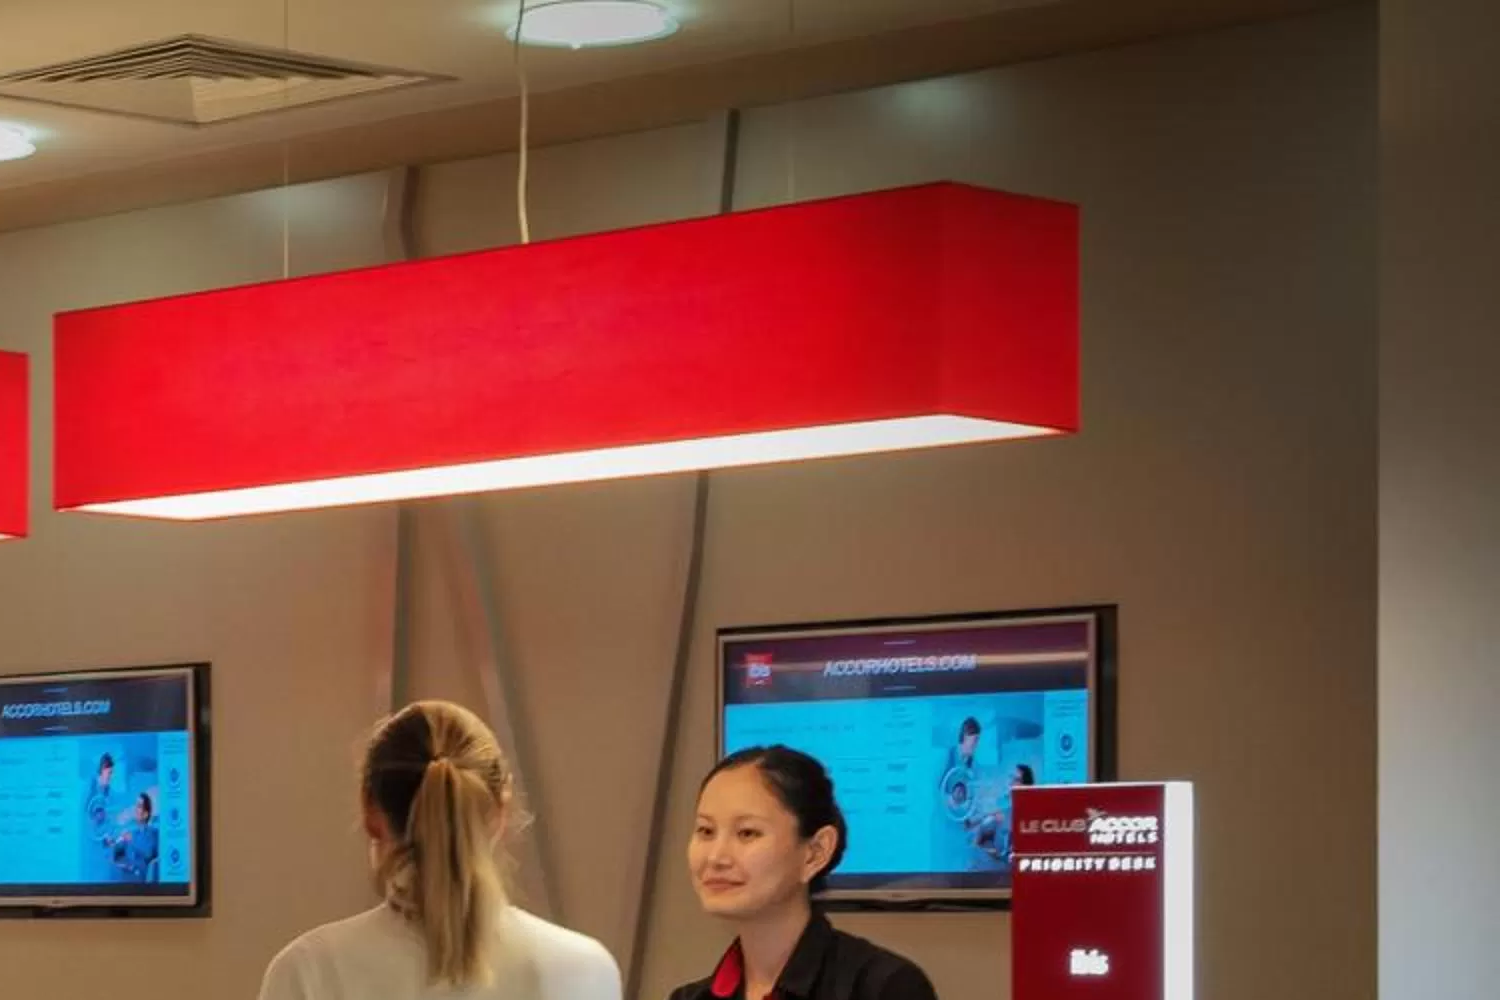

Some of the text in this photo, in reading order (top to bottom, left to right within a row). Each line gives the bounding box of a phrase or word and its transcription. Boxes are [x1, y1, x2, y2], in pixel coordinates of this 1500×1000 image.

[823, 654, 977, 677] ACCORHOTELS.COM
[2, 699, 111, 718] ACCORHOTELS.COM
[1020, 815, 1158, 833] LE CLUB ACCOR
[1090, 831, 1158, 844] HOTELS
[1019, 856, 1156, 871] PRIORITY DESK
